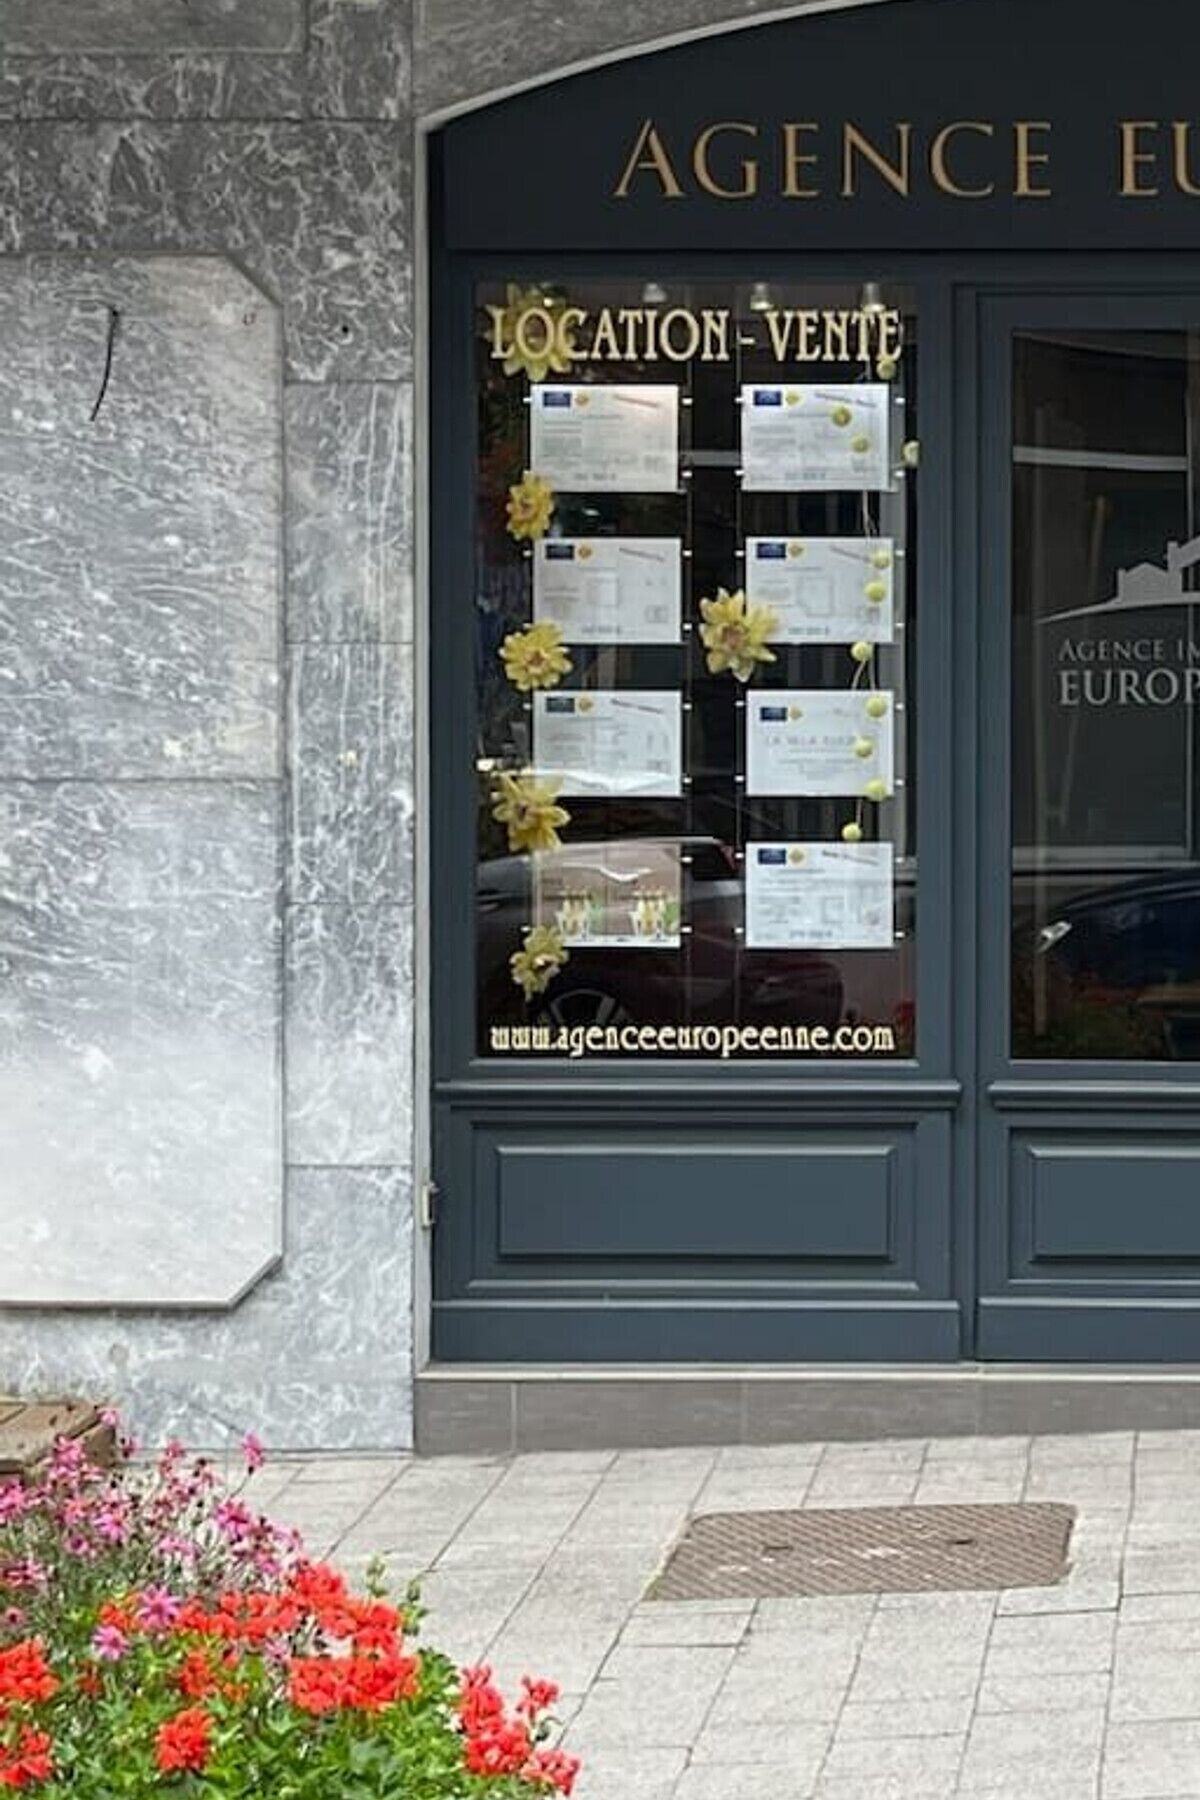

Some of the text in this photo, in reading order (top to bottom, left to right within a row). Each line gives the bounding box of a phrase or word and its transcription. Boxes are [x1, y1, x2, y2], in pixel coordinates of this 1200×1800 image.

[613, 118, 1052, 199] AGENCE
[490, 307, 730, 362] LOCATION
[765, 309, 902, 362] VENTE
[1058, 638, 1165, 662] AGENCE
[490, 1024, 895, 1057] www.agenceeuropeenne.com
